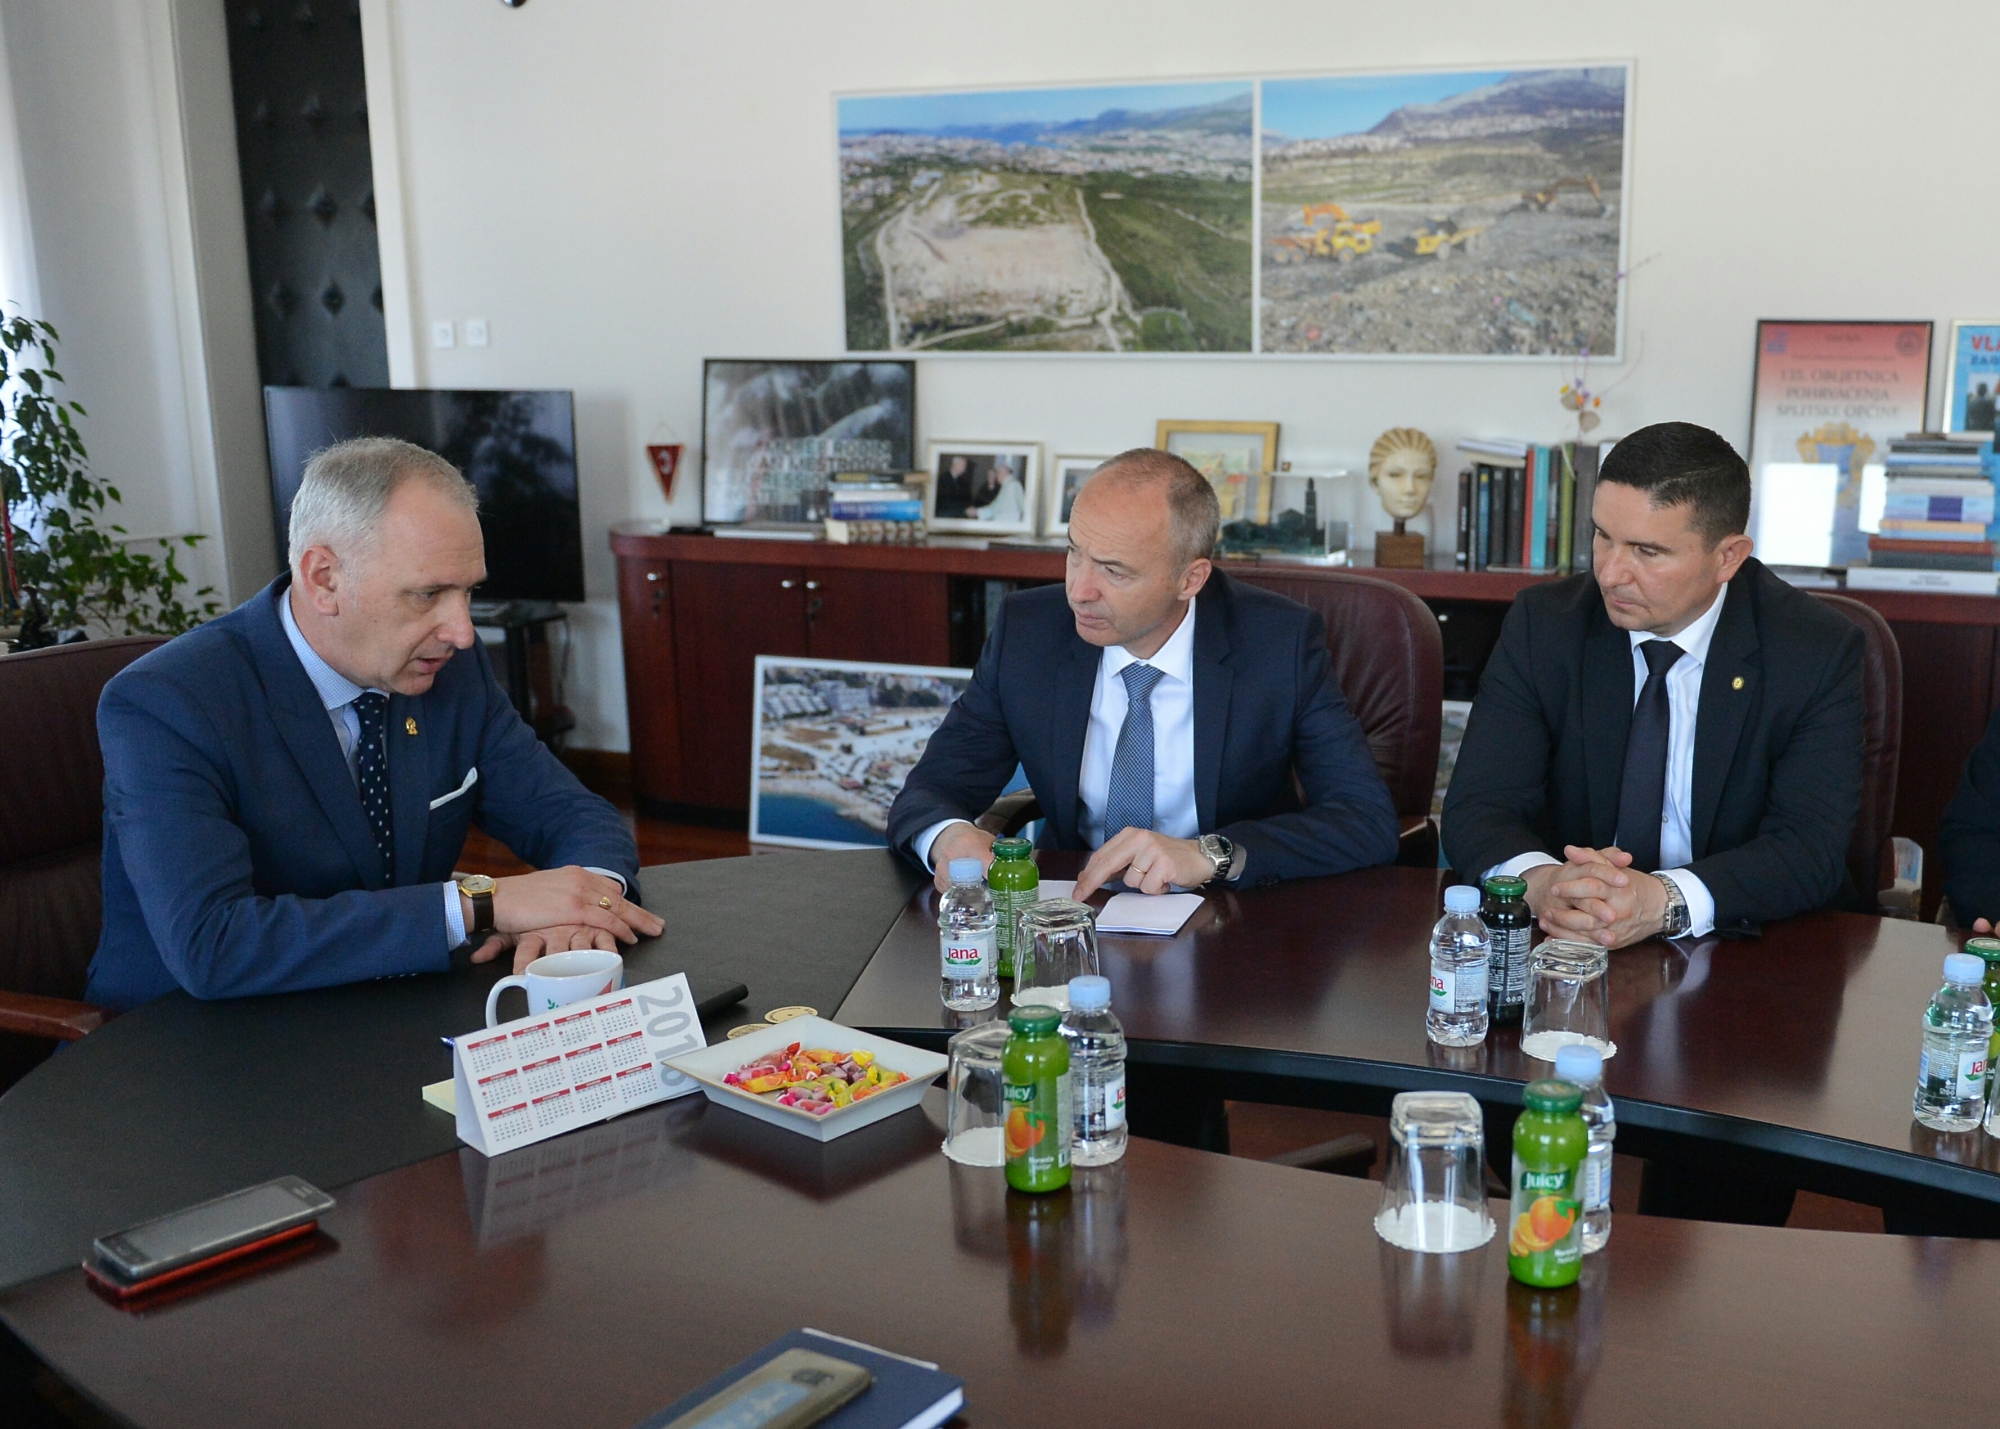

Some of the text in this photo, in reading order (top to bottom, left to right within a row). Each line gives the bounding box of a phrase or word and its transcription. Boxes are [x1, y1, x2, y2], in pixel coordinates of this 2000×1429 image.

[947, 947, 979, 960] Jana
[1970, 1058, 1988, 1077] Jan
[1525, 1172, 1565, 1190] Juicy
